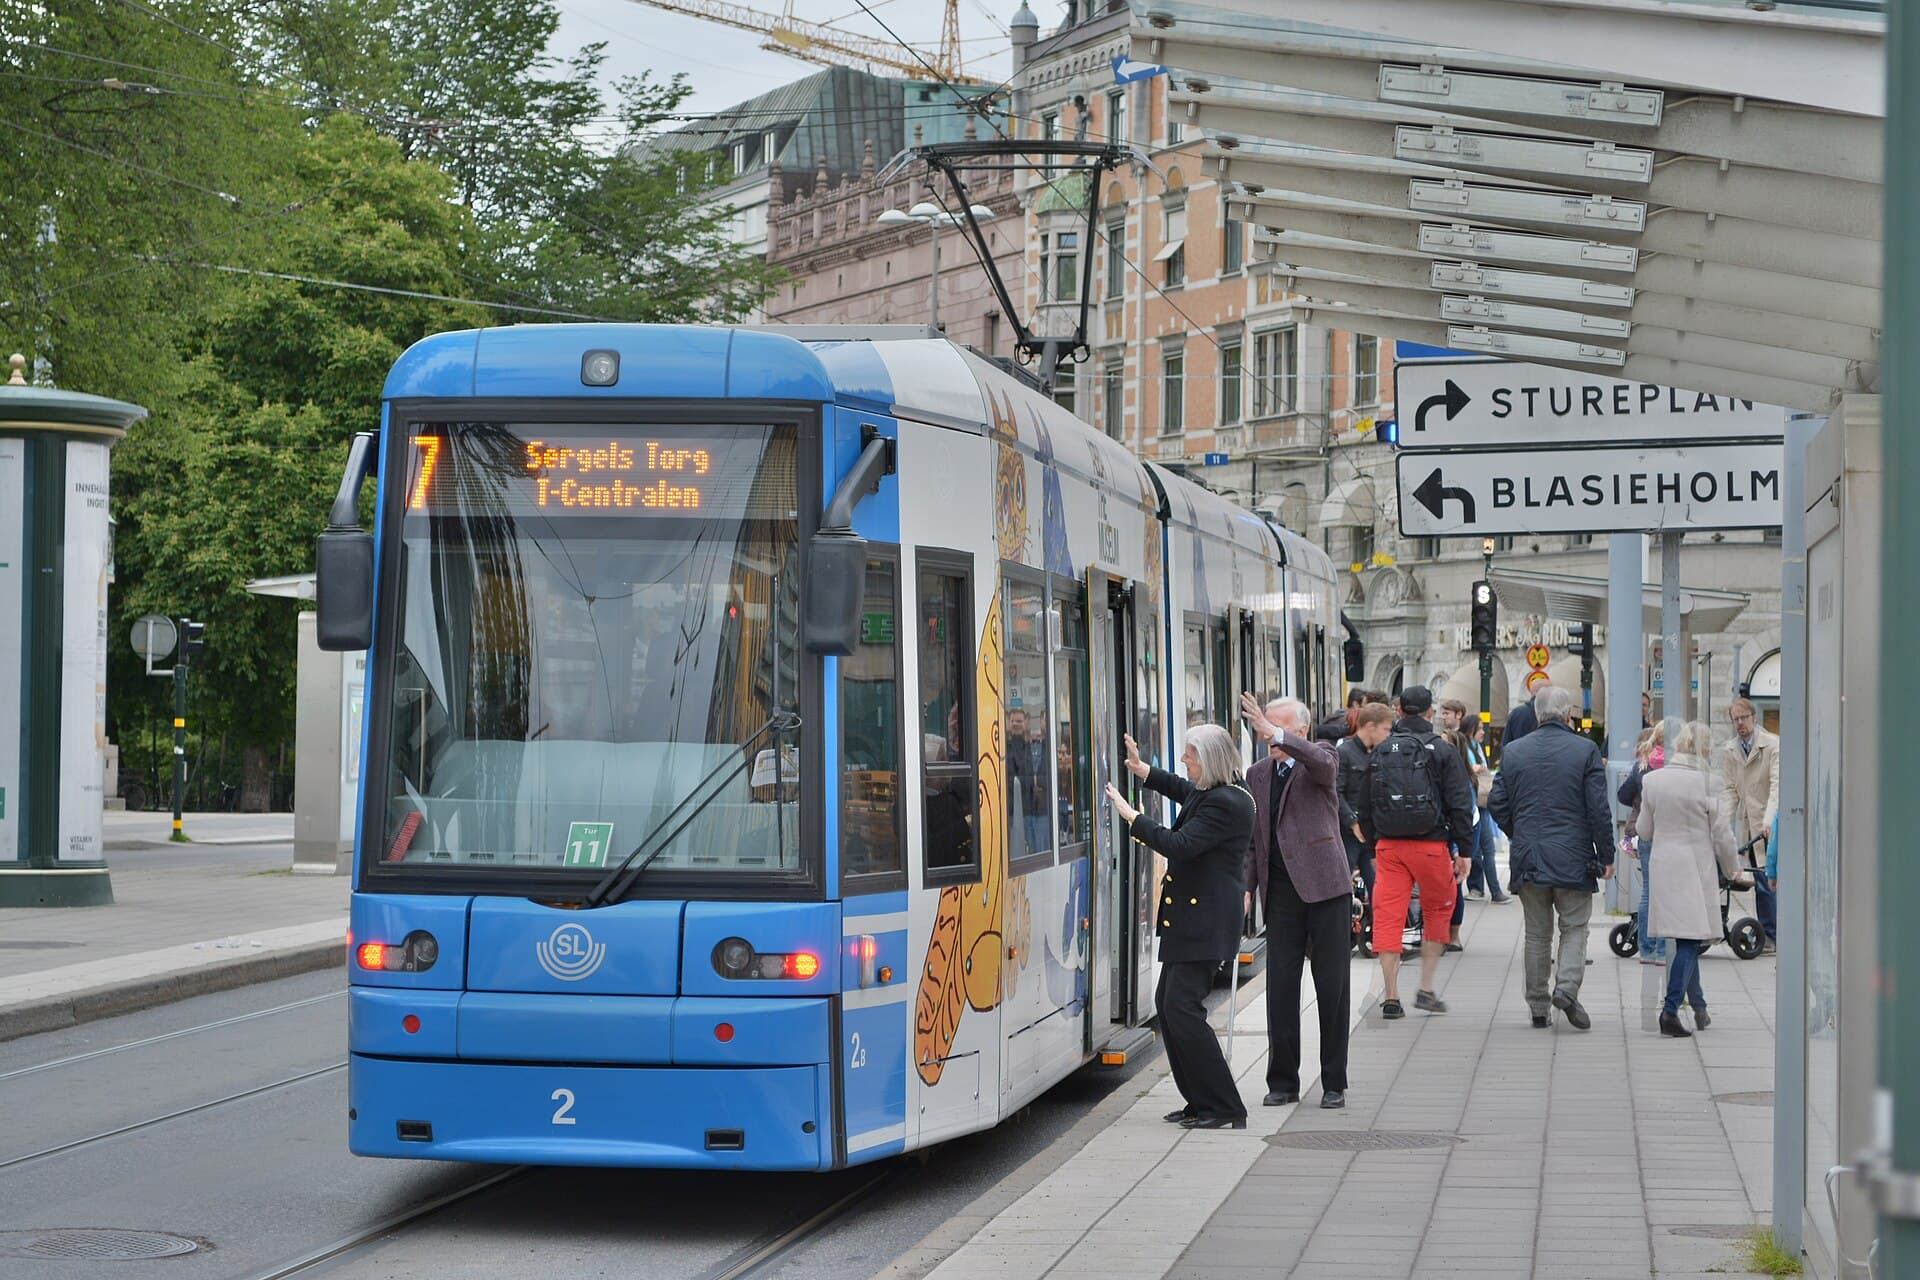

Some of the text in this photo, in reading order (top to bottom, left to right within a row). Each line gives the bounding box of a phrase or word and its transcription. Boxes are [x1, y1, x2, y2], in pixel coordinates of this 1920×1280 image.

[409, 436, 440, 509] 7
[526, 440, 710, 474] Sergels Torg
[536, 478, 701, 508] T-Centralen
[1492, 469, 1779, 510] BLASIEHOLM
[571, 840, 600, 864] 11
[557, 934, 585, 956] SL
[551, 1088, 577, 1125] 2
